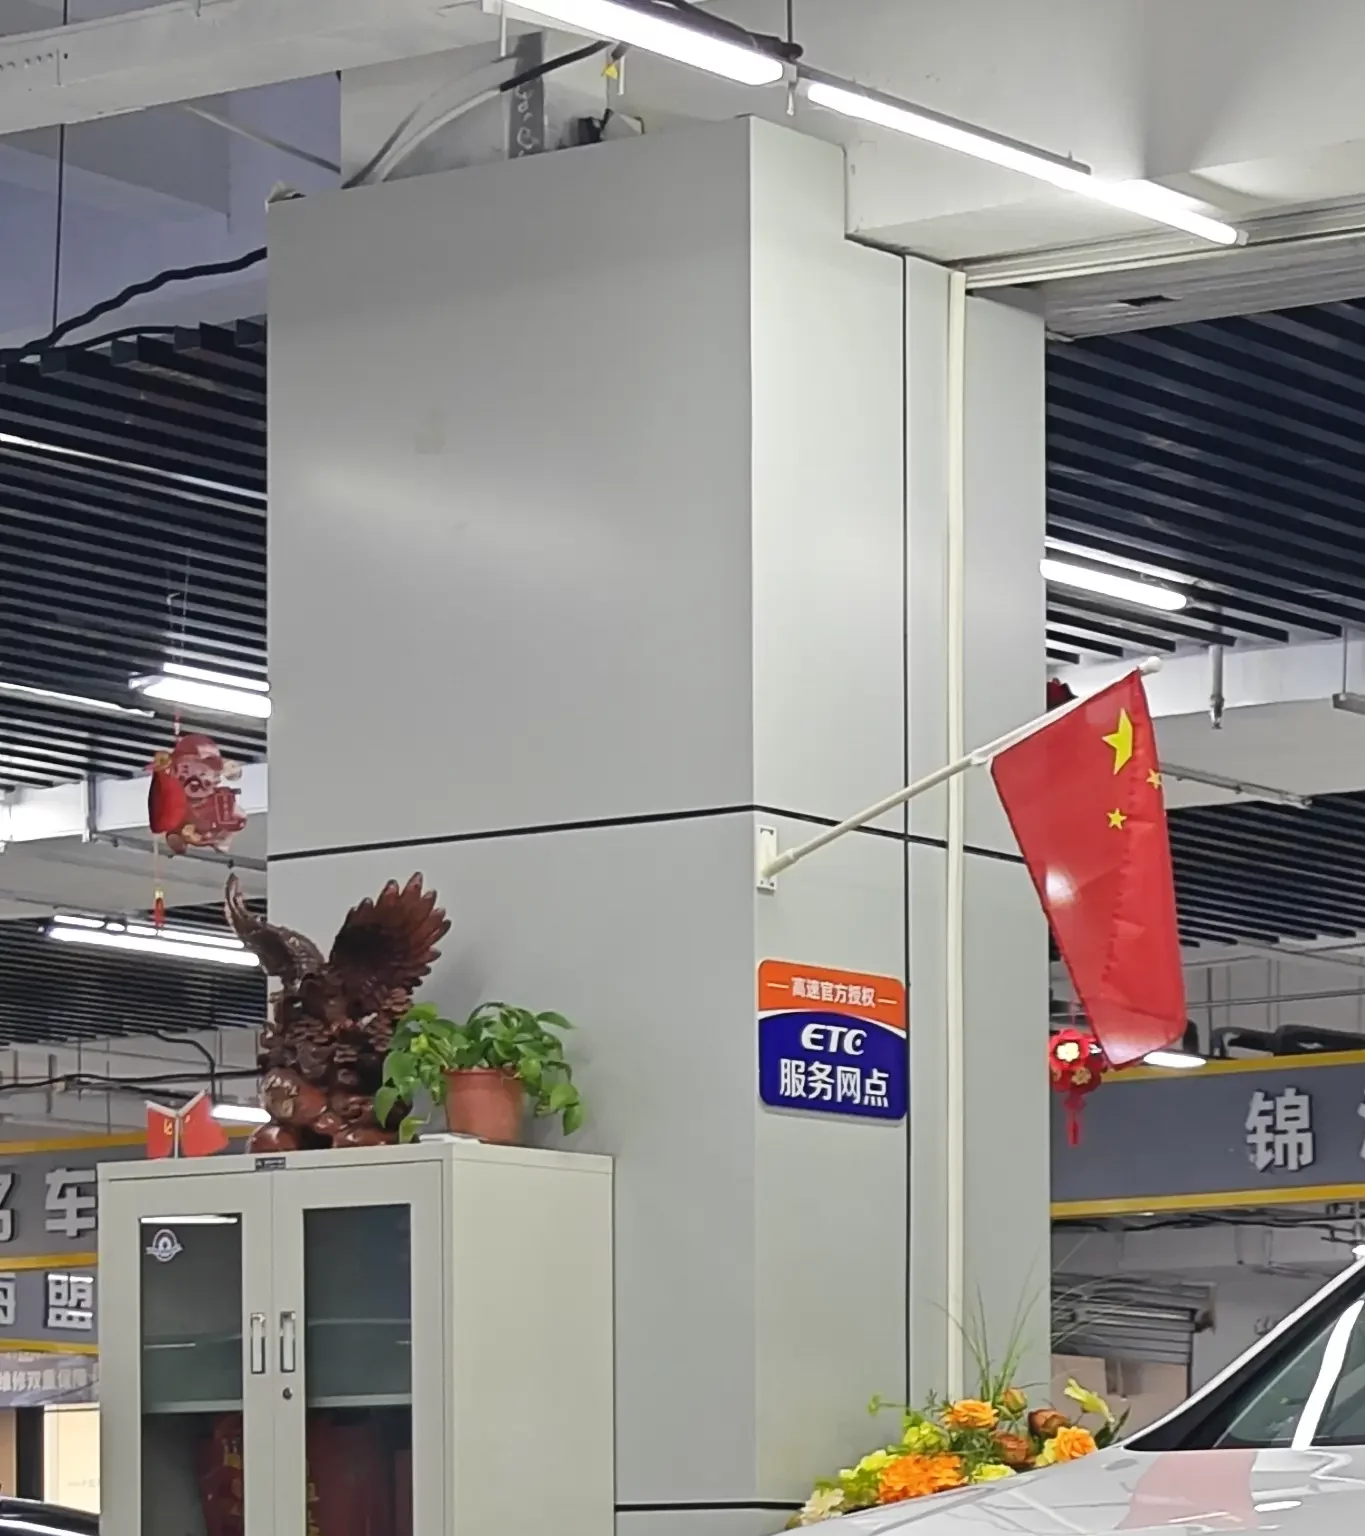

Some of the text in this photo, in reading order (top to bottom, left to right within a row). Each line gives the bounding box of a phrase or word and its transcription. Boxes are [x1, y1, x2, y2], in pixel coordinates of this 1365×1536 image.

[791, 977, 876, 1008] 高速官方授权
[801, 1023, 867, 1056] ETC
[779, 1058, 889, 1108] 服务网点
